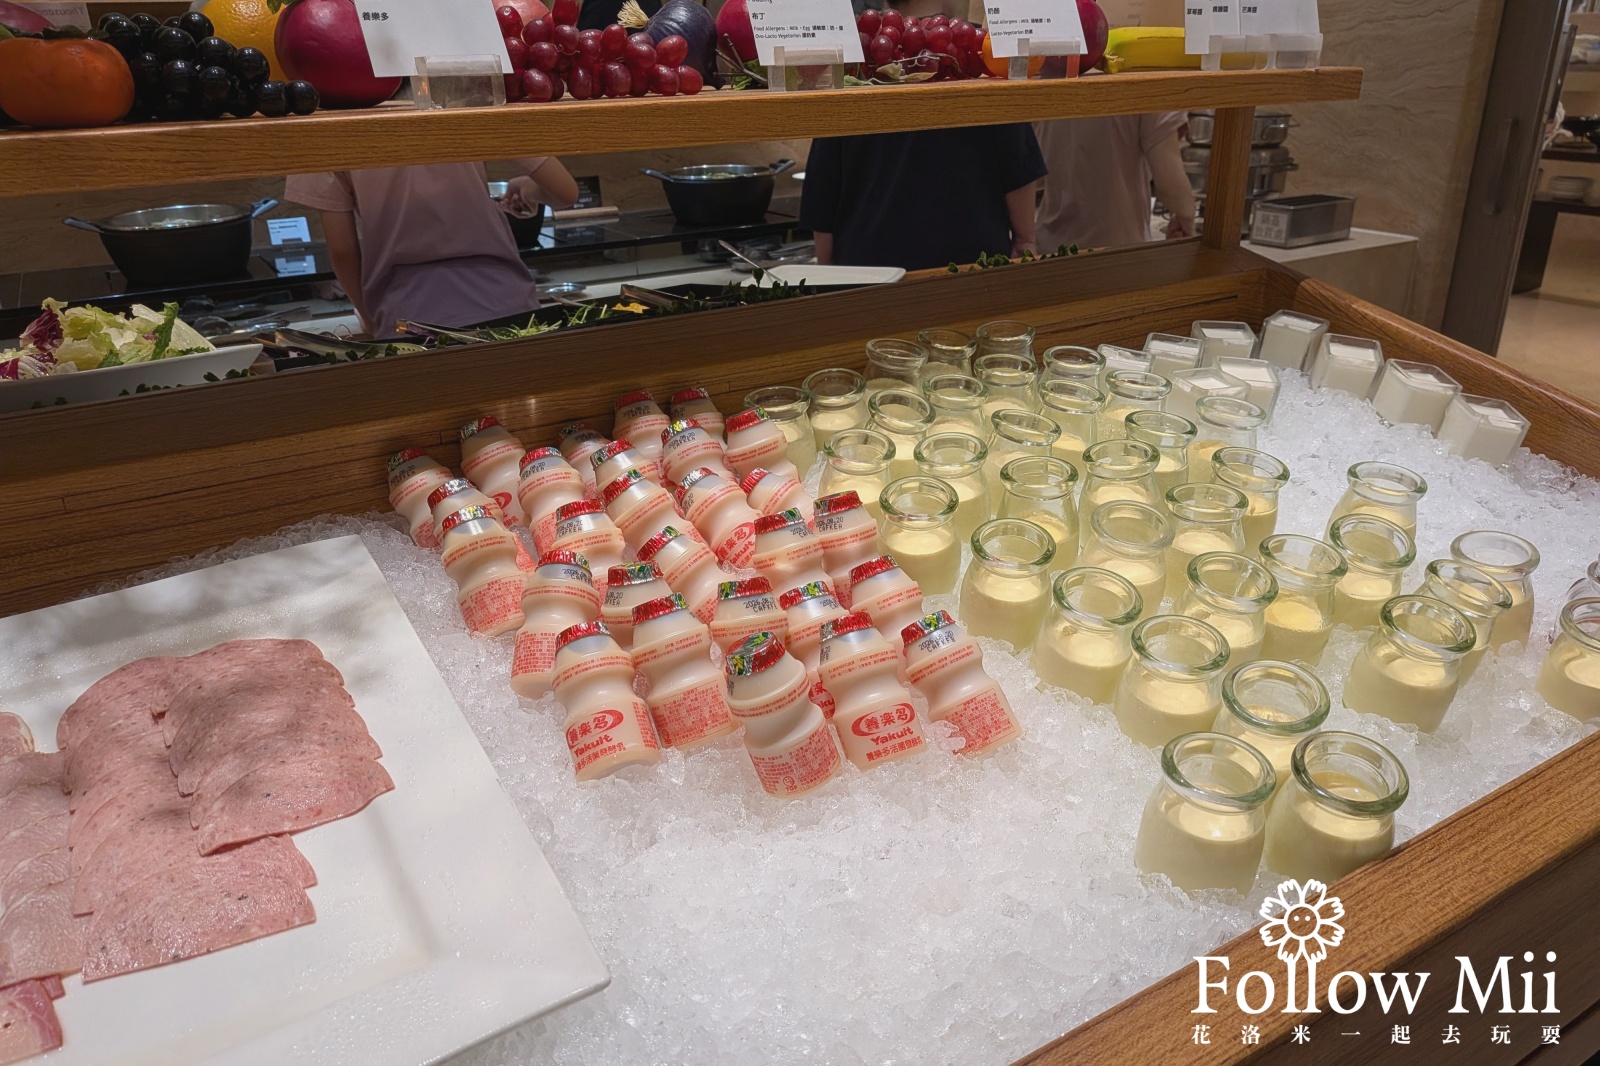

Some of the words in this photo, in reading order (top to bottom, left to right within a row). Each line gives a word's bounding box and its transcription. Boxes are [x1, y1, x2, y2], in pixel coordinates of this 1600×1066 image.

[363, 11, 389, 20] 養樂多
[752, 12, 765, 20] 布丁
[870, 727, 913, 745] Yakult
[574, 734, 613, 757] Yakult
